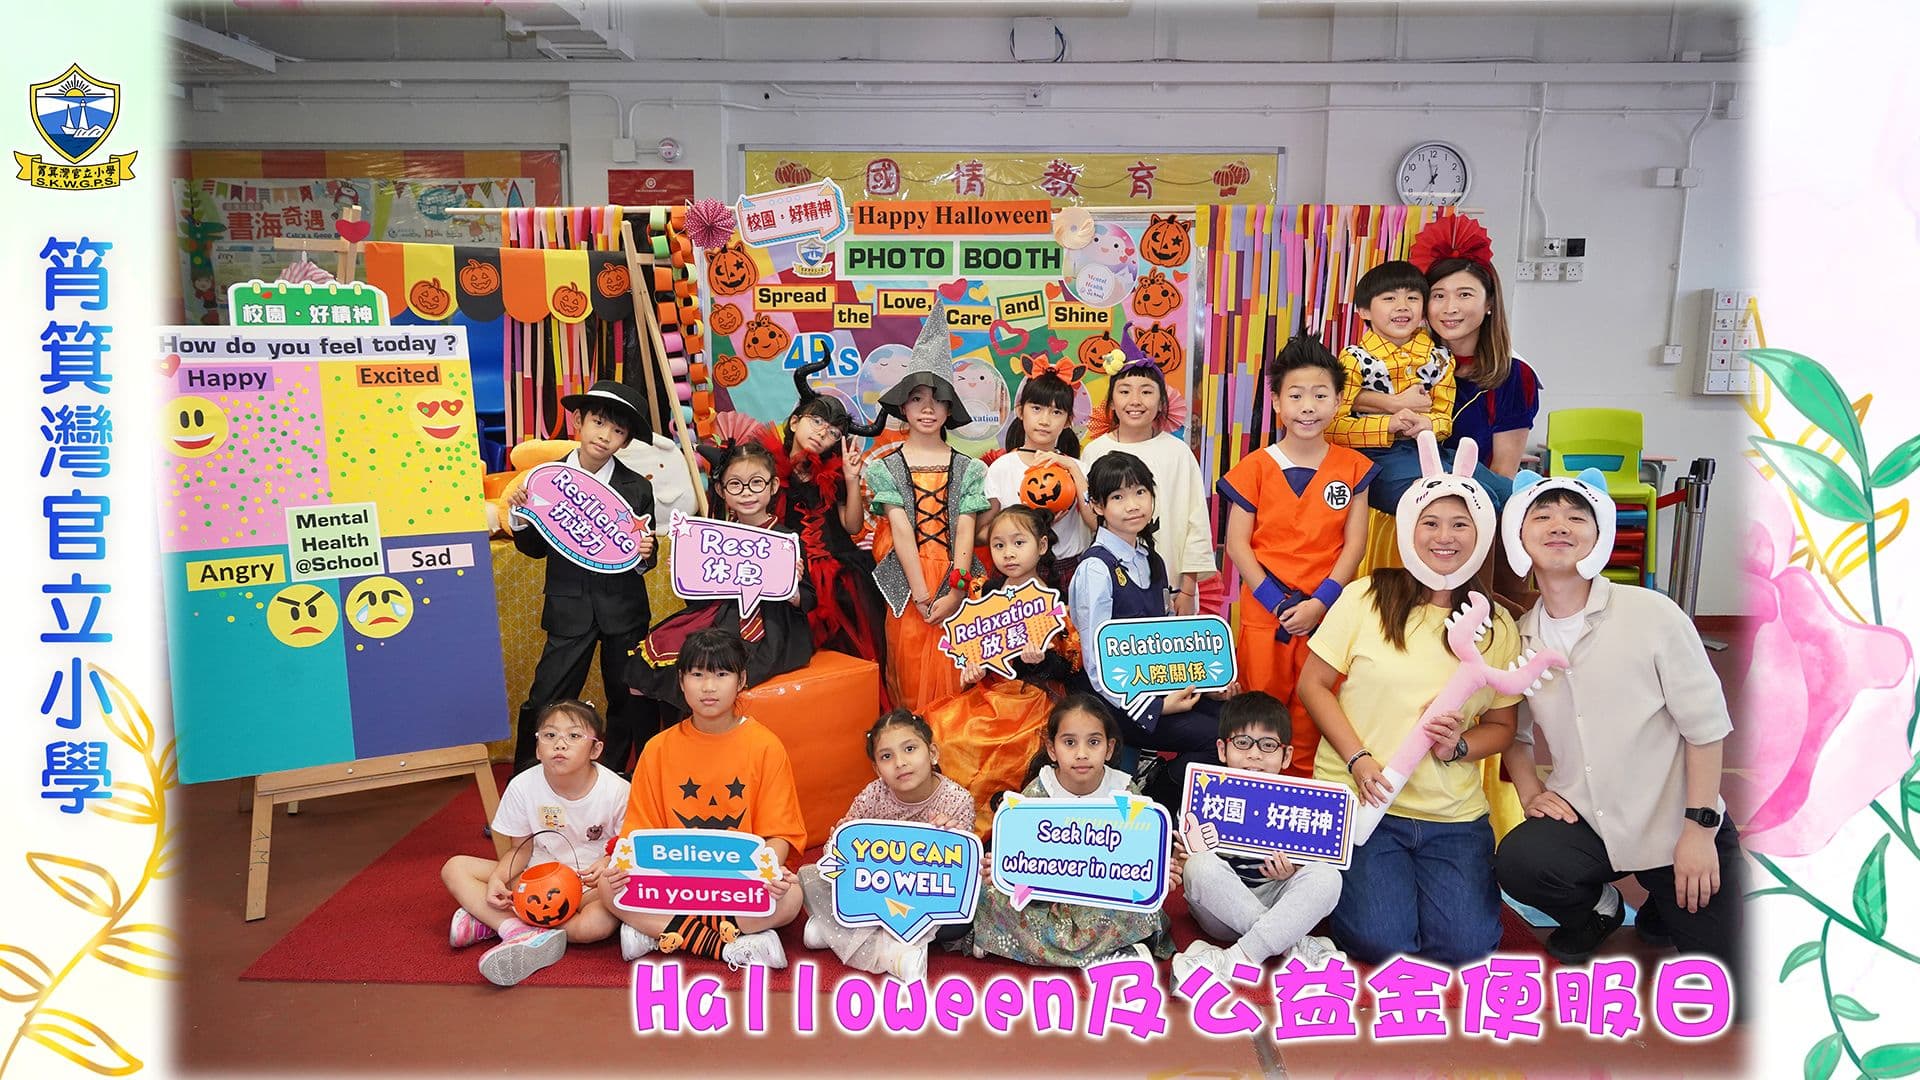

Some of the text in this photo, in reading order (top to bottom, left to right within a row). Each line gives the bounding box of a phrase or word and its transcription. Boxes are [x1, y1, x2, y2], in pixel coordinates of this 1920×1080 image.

[866, 158, 1157, 198] 國情教育
[1408, 163, 1416, 171] 10
[227, 206, 325, 240] 書海奇遇
[858, 204, 1051, 231] Happy Halloween
[849, 247, 1061, 270] PHOTO BOOTH
[758, 288, 1109, 326] Spread the Love, Care and Shine
[159, 335, 216, 354] How
[226, 337, 256, 354] do
[268, 340, 310, 359] you
[320, 337, 363, 355] feel
[373, 334, 437, 356] today
[784, 333, 860, 376] 4Rs
[188, 369, 268, 390] Happy
[360, 365, 440, 386] Excited
[1327, 485, 1349, 506] 悟
[296, 509, 369, 529] Mental
[551, 469, 636, 553] Resilience
[550, 500, 607, 556] 抗逆力
[301, 533, 369, 552] Health
[701, 529, 771, 559] Rest
[295, 553, 379, 574] @School
[411, 548, 452, 568] Sad
[199, 560, 275, 584] Angry
[702, 557, 763, 586] 休息
[955, 596, 1046, 643] Relaxation
[981, 625, 1028, 658] 放鬆
[1106, 632, 1225, 657] Relationship
[1131, 662, 1208, 686] 人際關係
[1037, 819, 1122, 851] Seek help
[652, 844, 741, 863] Believe
[852, 837, 963, 868] YOU CAN
[1002, 852, 1153, 882] whenever in need
[638, 882, 765, 905] in yourself
[855, 867, 957, 897] DO WELL
